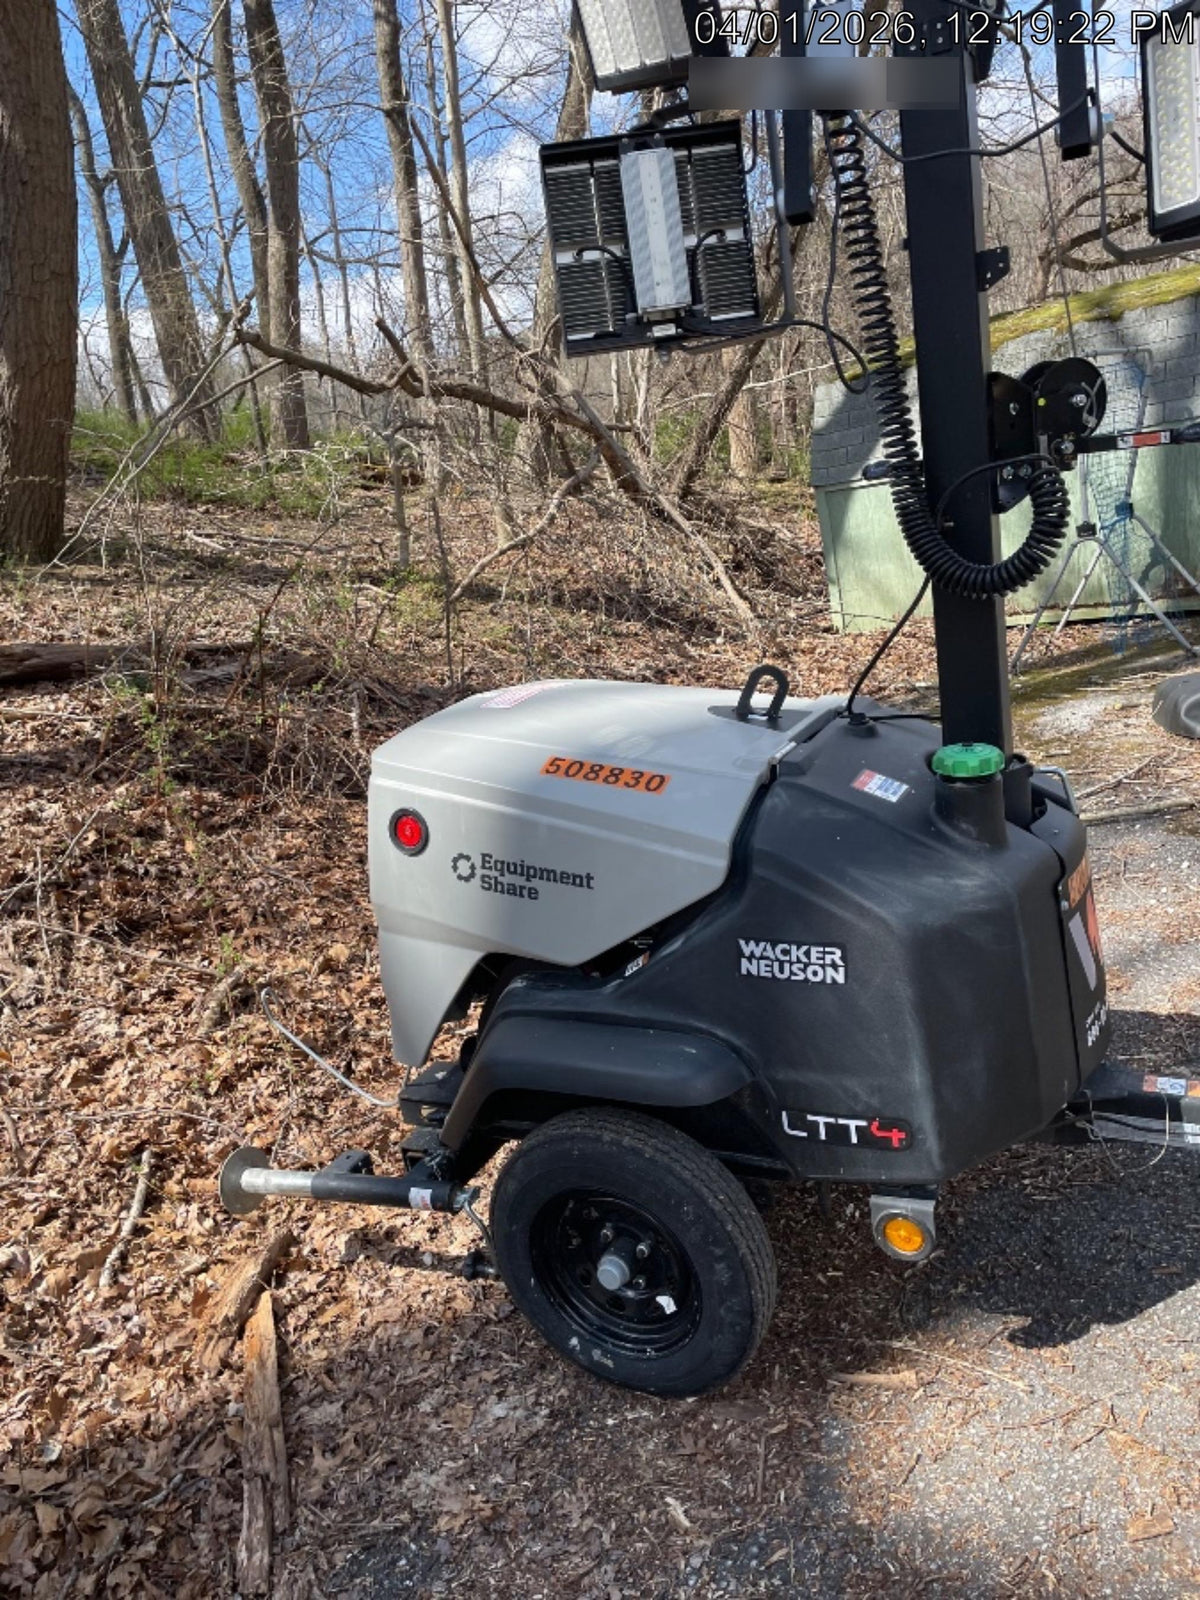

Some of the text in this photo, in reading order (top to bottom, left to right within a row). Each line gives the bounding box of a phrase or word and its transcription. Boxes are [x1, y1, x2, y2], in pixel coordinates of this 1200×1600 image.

[545, 757, 665, 792] 508830
[480, 853, 594, 890] Equipment
[480, 874, 540, 900] Share
[738, 938, 845, 966] WACKER
[740, 958, 845, 984] NEUSON
[781, 1110, 906, 1148] LTT4
